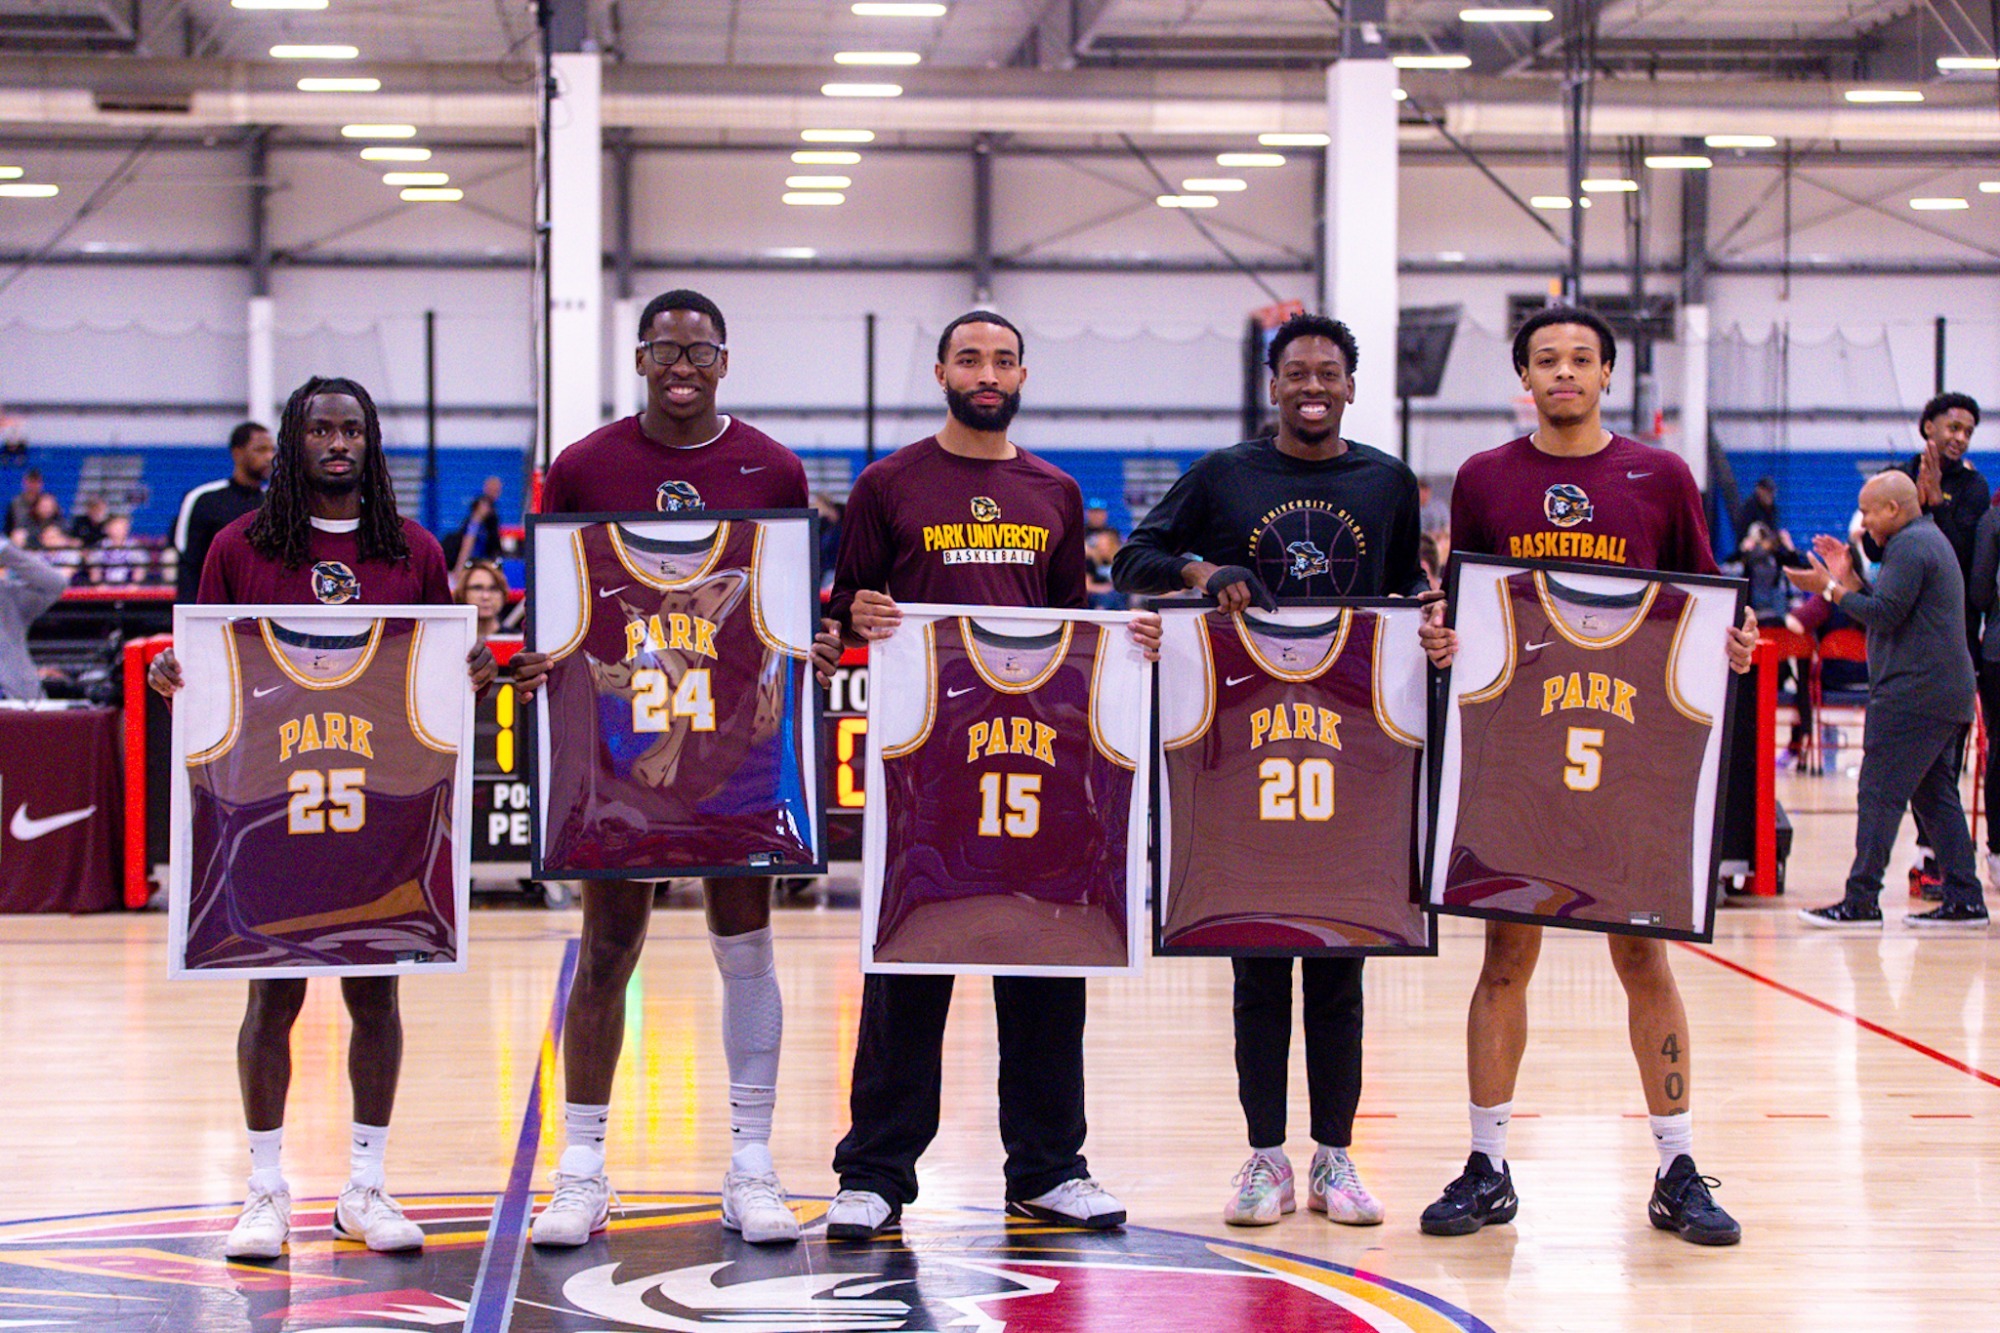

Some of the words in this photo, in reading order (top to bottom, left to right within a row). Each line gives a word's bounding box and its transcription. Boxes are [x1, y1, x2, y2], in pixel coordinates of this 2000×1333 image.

[922, 523, 967, 552] PARK
[966, 523, 1050, 552] UNIVERSITY
[1261, 500, 1334, 525] UNIVERSITY
[944, 550, 1034, 564] BASKETBALL
[1509, 531, 1627, 564] BASKETBALL
[624, 612, 719, 661] PARK
[631, 667, 717, 733] 24
[1541, 671, 1637, 725] PARK
[279, 711, 374, 762] PARK
[966, 716, 1057, 767] PARK
[1250, 703, 1342, 751] PARK
[1563, 726, 1605, 792] 5
[287, 767, 366, 835] 25
[493, 782, 531, 809] PO
[977, 772, 1042, 838] 15
[1258, 757, 1335, 822] 20
[487, 812, 532, 845] PE
[1661, 1033, 1685, 1115] 40
